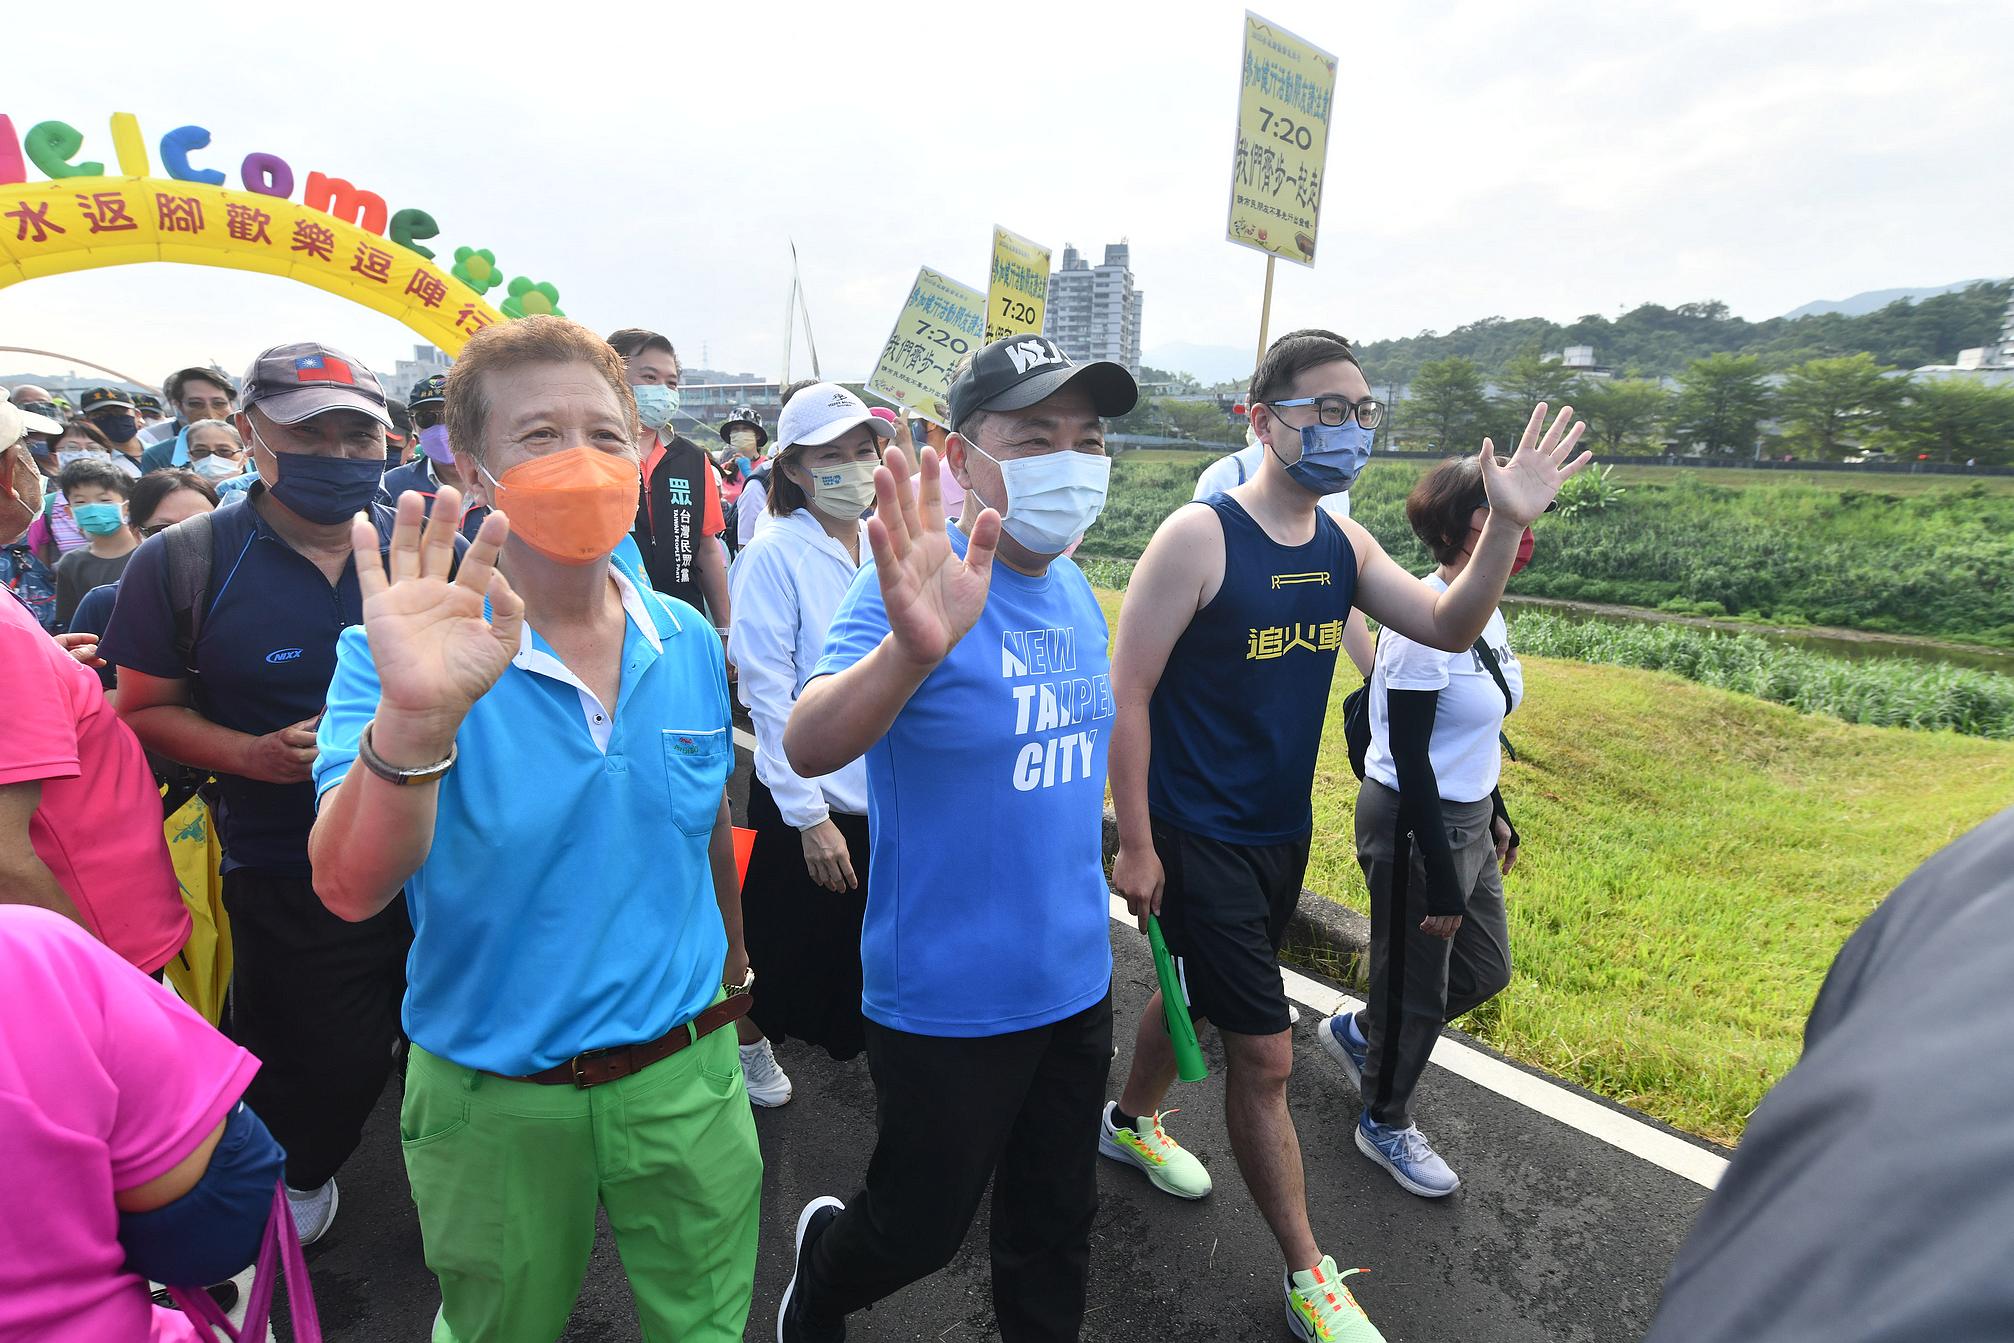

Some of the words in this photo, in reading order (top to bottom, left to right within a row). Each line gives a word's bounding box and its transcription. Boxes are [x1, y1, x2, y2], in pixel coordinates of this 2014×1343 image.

[1259, 107, 1312, 151] 7:20
[1235, 138, 1319, 214] 我們齊步一起走
[4, 191, 494, 337] 水返腳歡樂逗陣行
[1002, 297, 1036, 325] 7:20
[915, 319, 969, 354] 7:20
[273, 650, 302, 662] NIXX
[1001, 627, 1077, 678] NEW
[1246, 619, 1344, 660] 追火車
[1012, 729, 1098, 792] CITY
